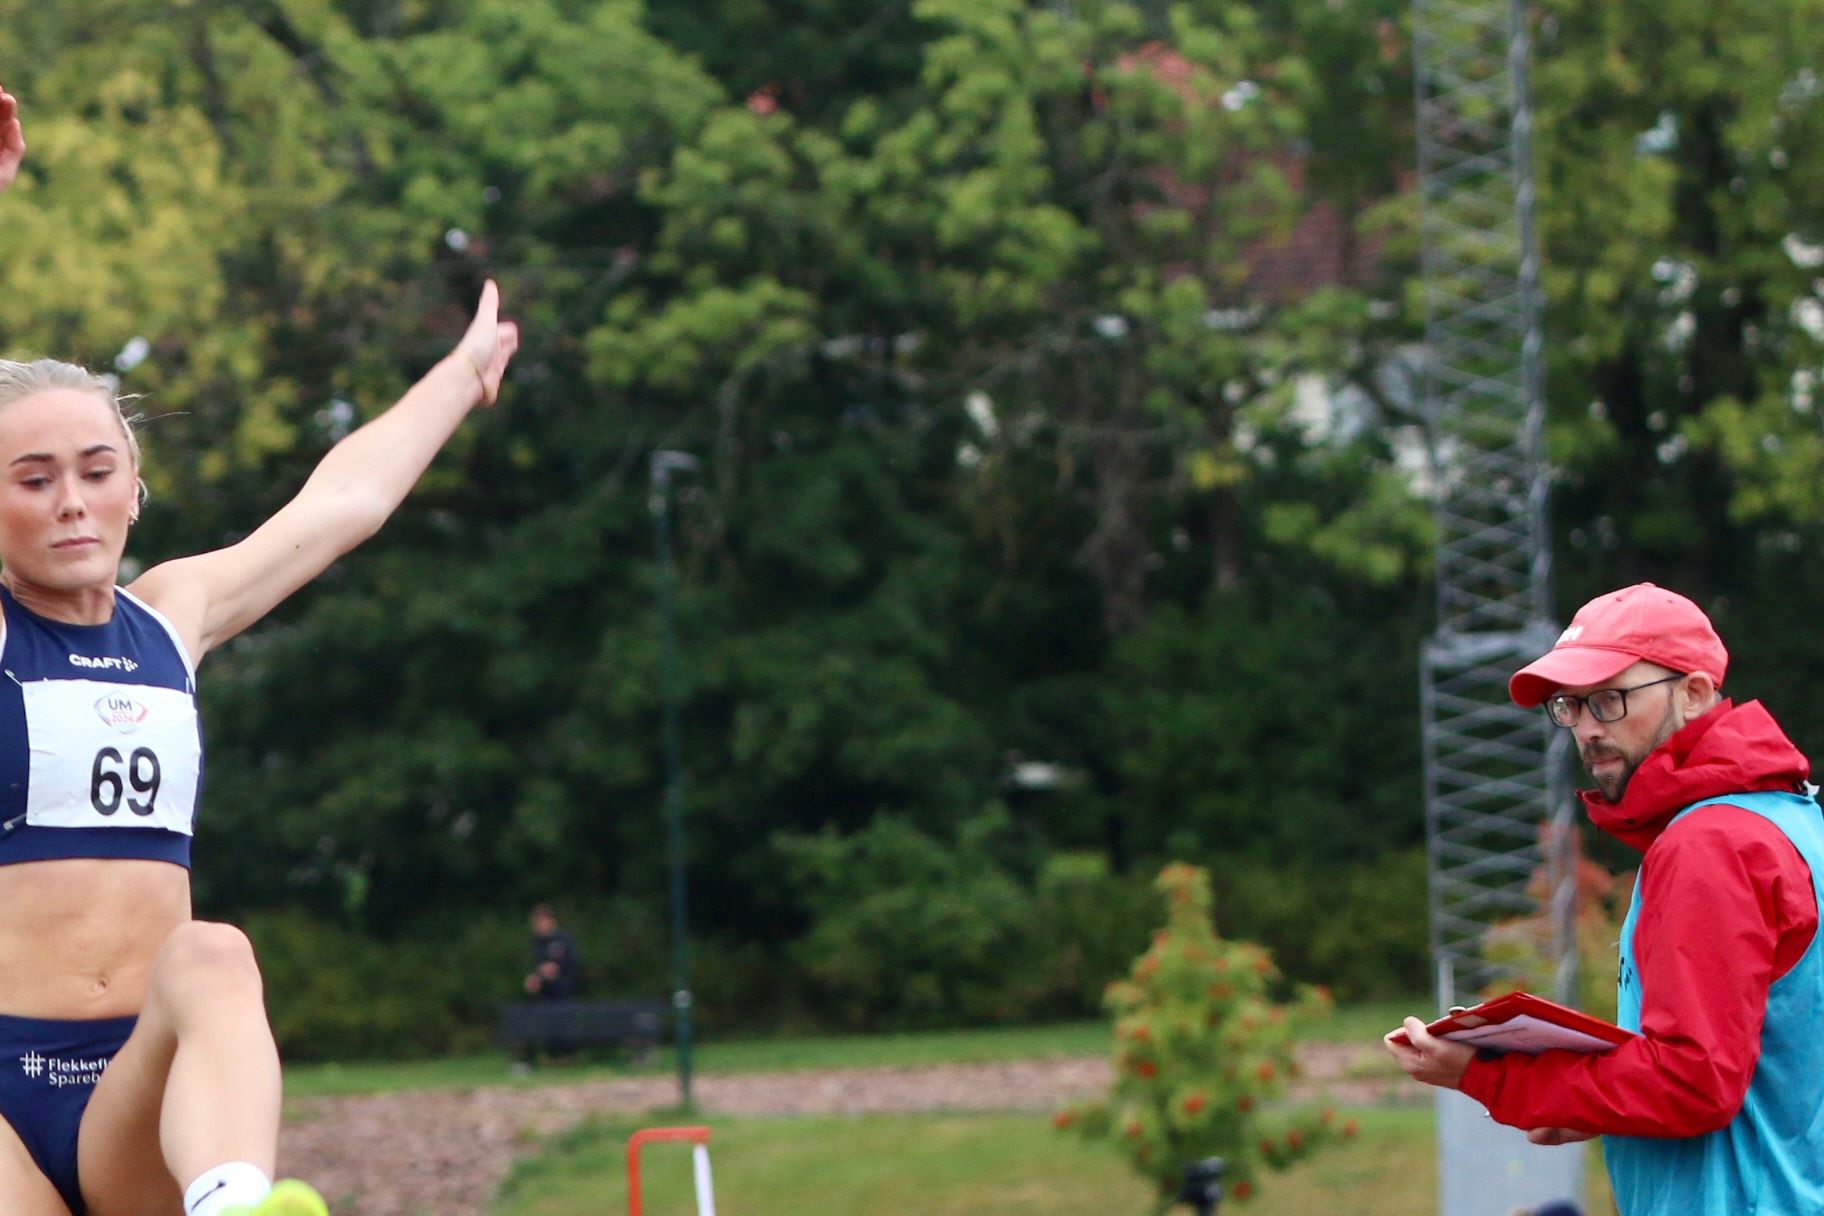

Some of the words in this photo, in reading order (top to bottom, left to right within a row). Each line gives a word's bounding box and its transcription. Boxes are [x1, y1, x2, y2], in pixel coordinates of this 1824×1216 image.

[68, 653, 122, 669] CRAFT
[107, 698, 133, 711] UM
[90, 746, 161, 817] 69
